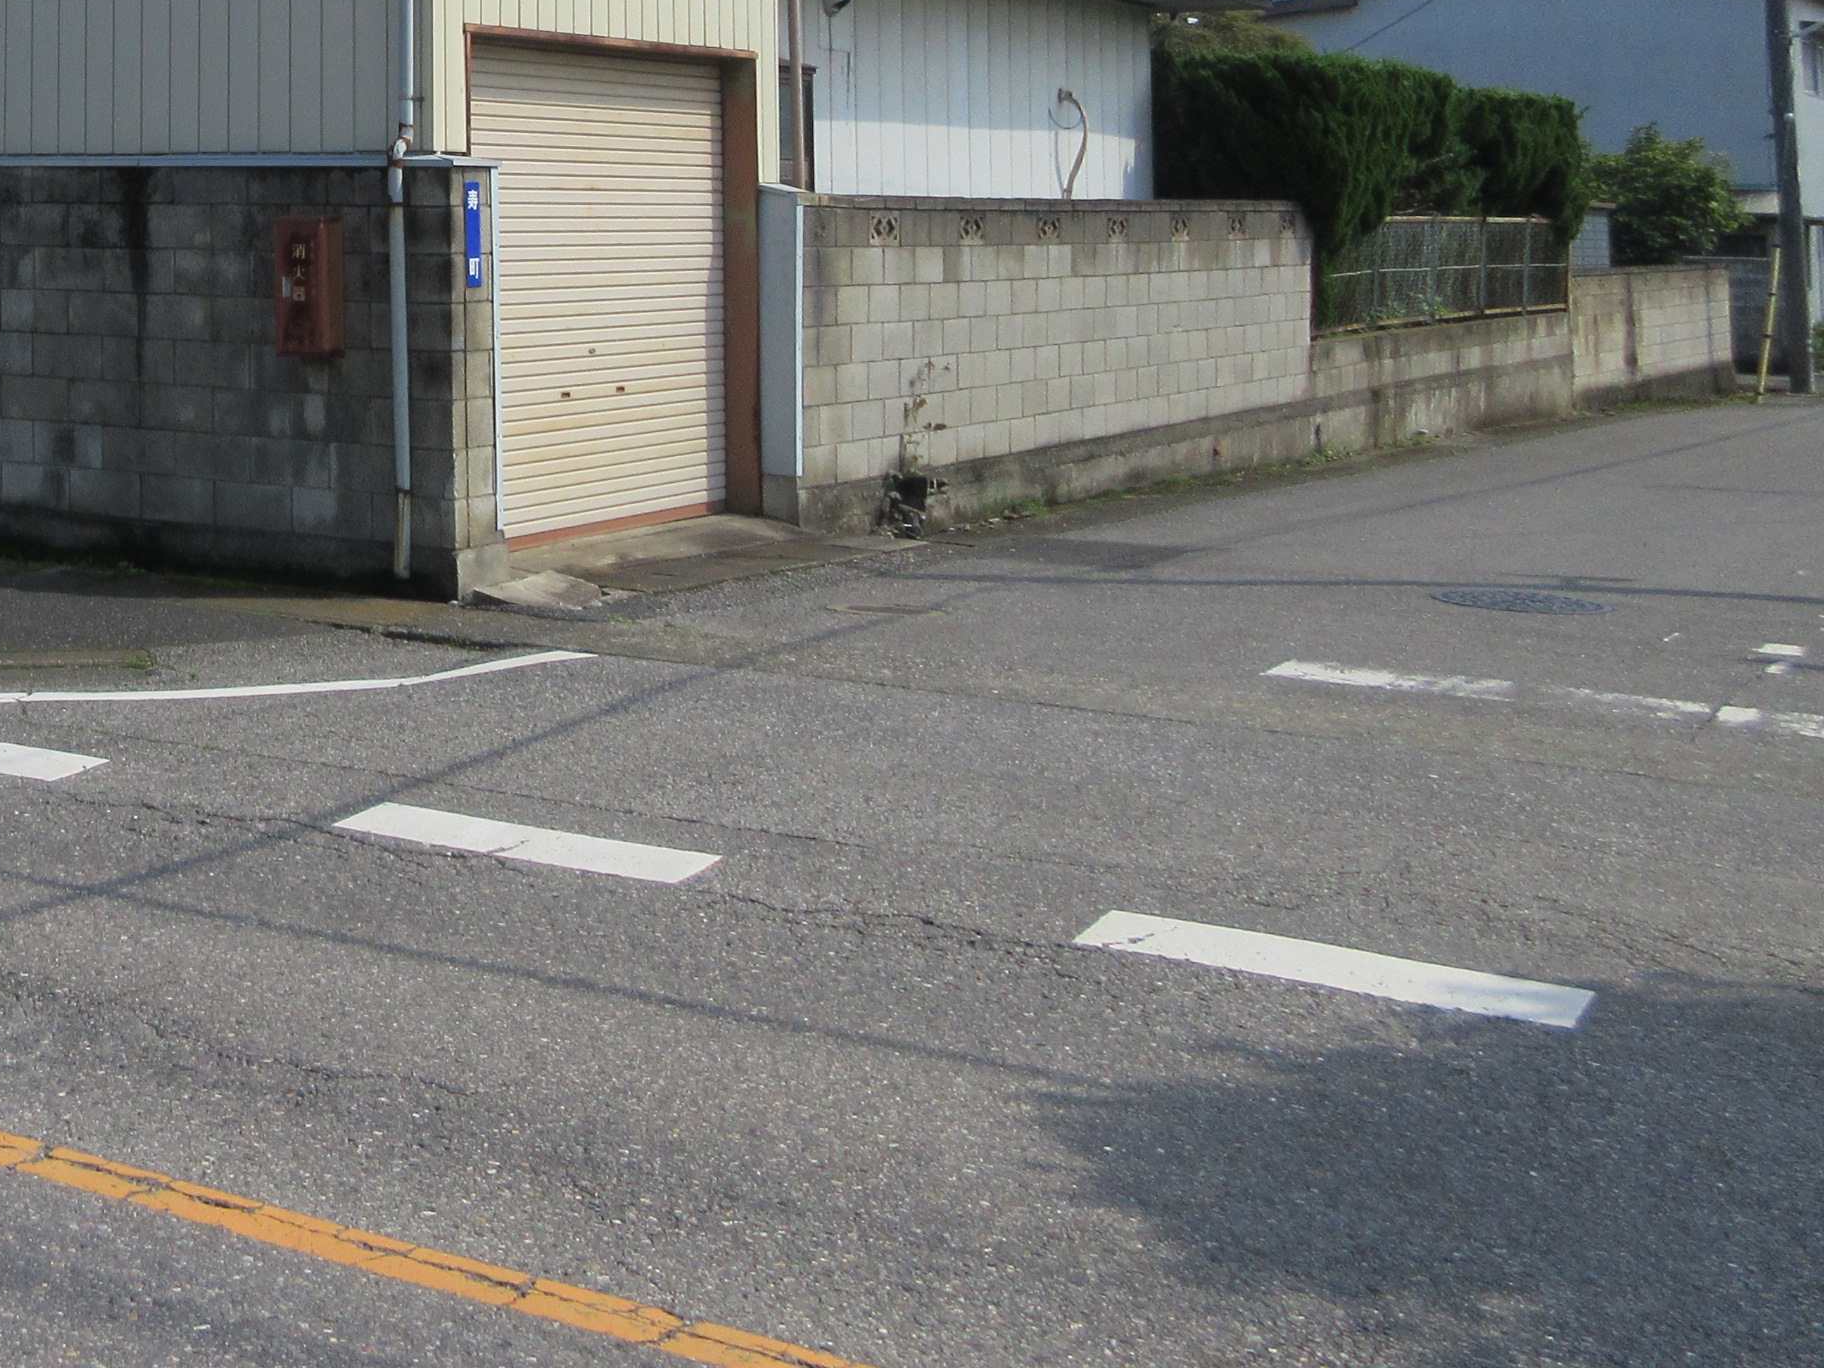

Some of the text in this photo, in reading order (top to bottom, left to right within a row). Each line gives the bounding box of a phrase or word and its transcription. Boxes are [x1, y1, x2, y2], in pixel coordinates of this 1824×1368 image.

[467, 190, 480, 279] 寿町
[292, 244, 306, 302] 消火器
